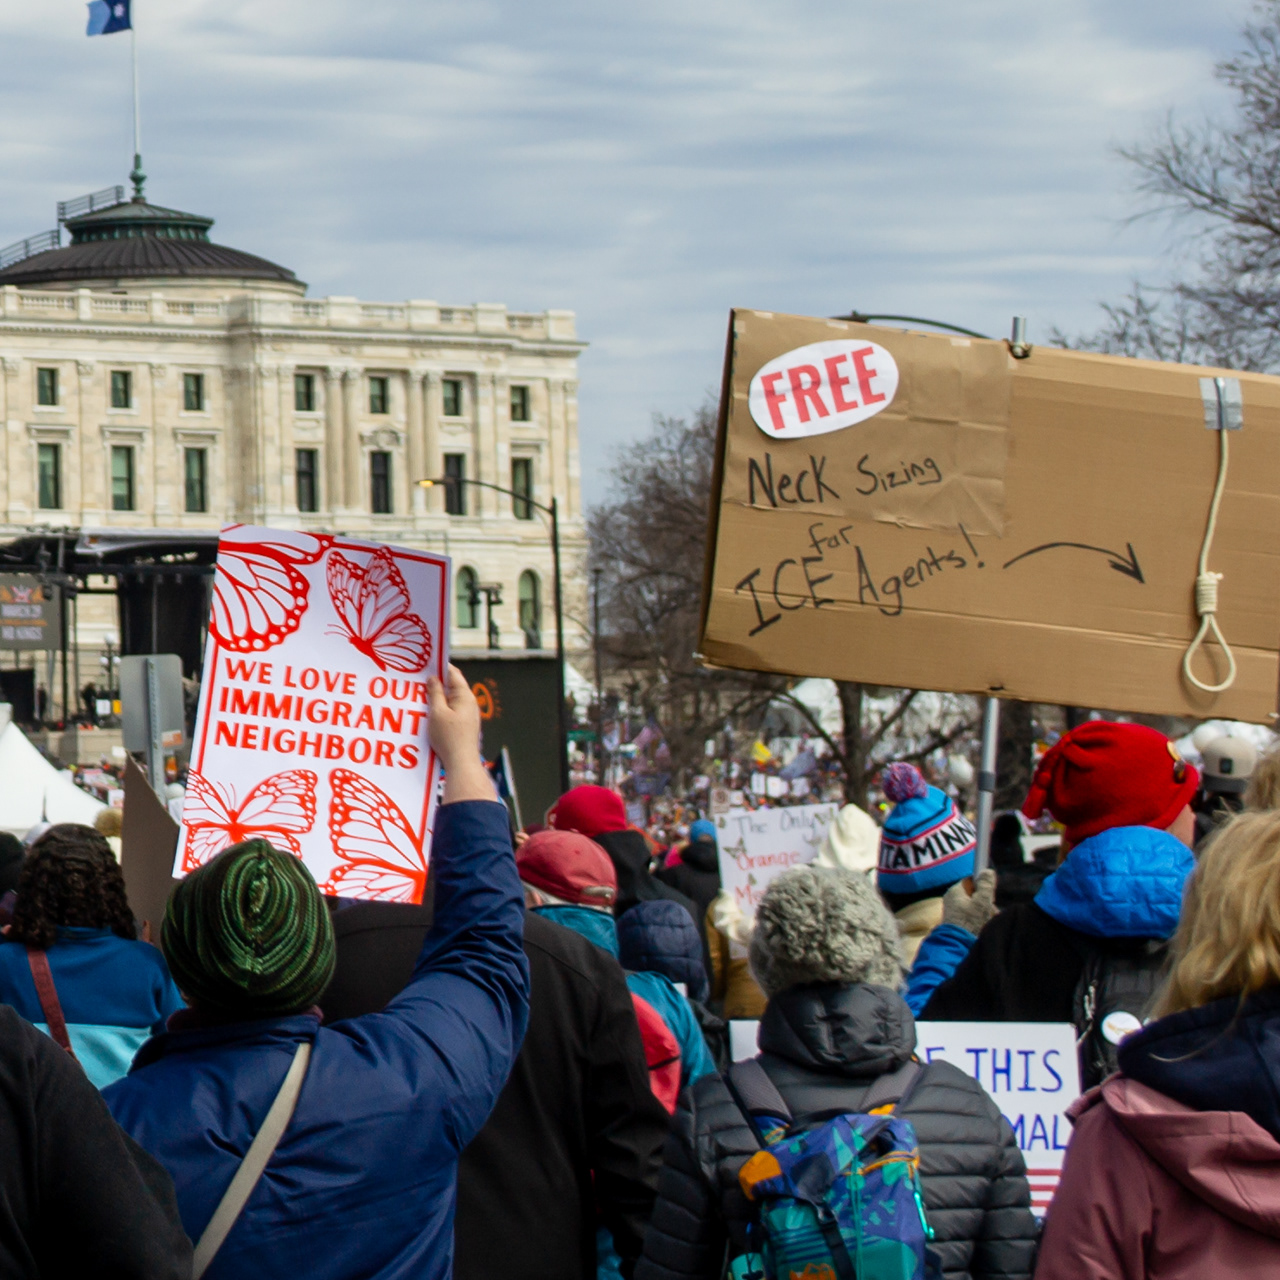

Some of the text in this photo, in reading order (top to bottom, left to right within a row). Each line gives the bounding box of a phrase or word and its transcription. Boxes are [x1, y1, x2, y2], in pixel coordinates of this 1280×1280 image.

[760, 345, 886, 431] FREE
[855, 453, 943, 496] Sizing
[808, 522, 854, 555] for
[735, 522, 986, 637] ICE Agents!
[224, 657, 428, 705] WE LOVE OUR
[218, 686, 428, 736] IMMIGRANT
[214, 720, 421, 770] NEIGHBORS
[731, 815, 768, 837] The
[735, 850, 801, 871] Orange
[965, 1047, 1064, 1094] THIS
